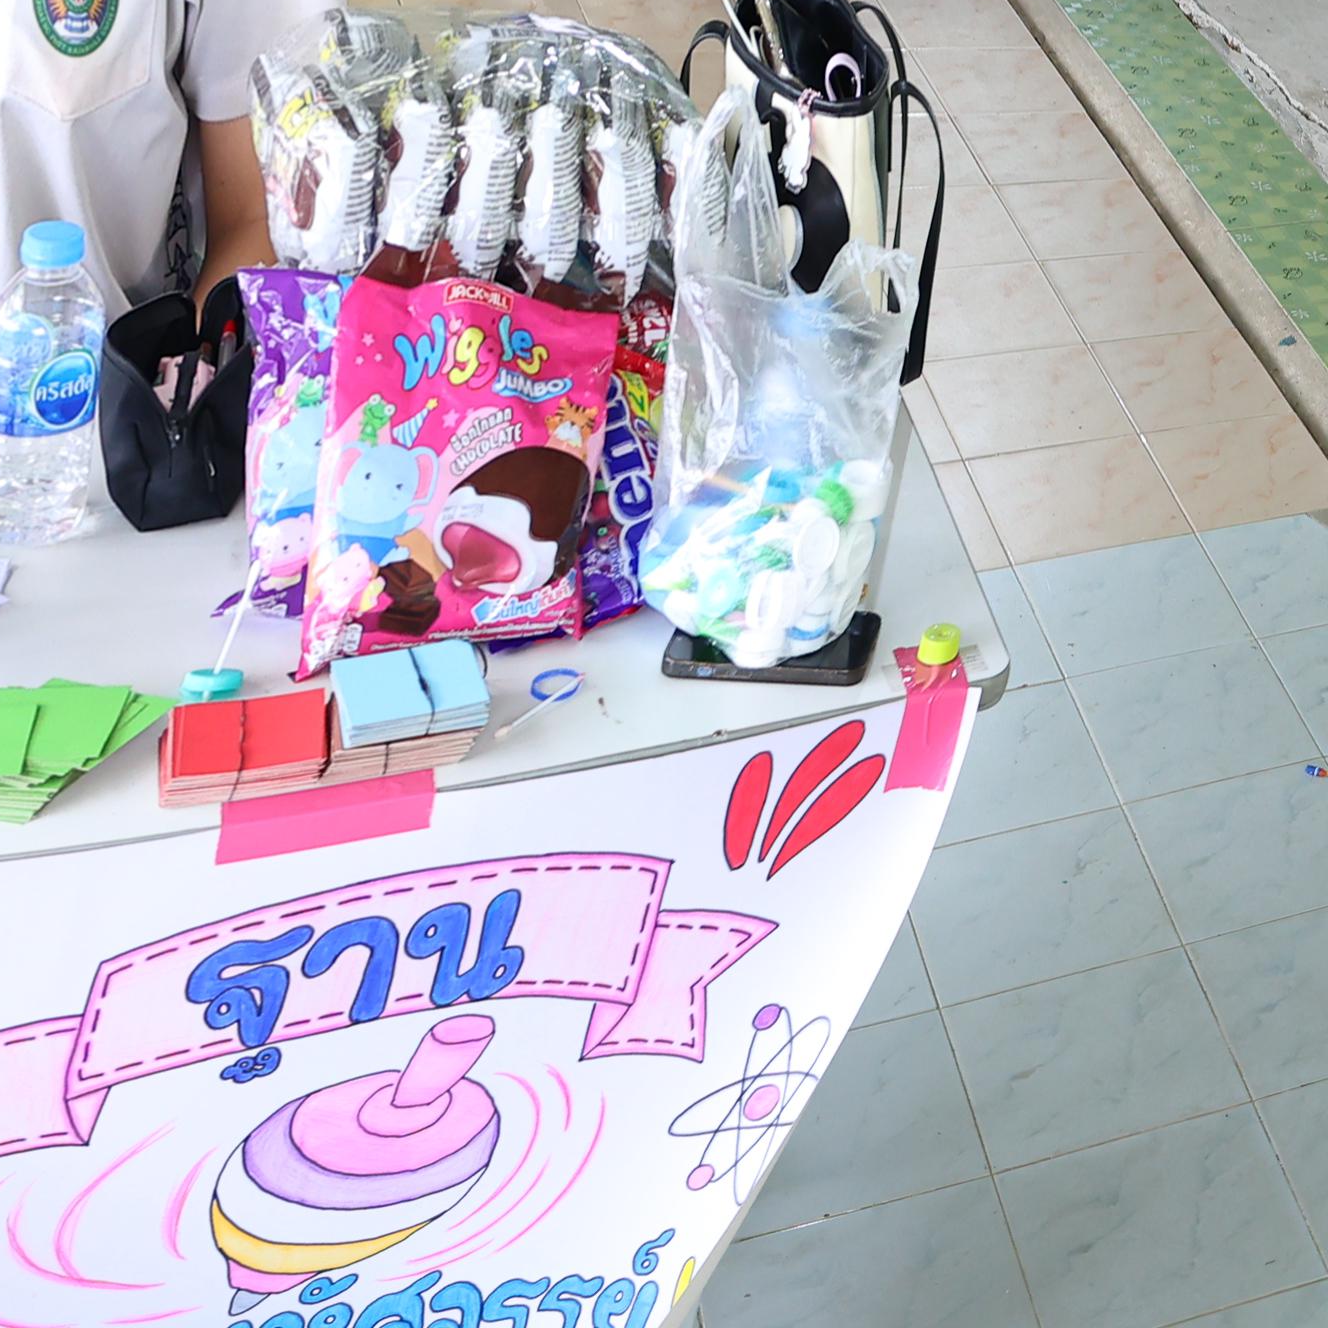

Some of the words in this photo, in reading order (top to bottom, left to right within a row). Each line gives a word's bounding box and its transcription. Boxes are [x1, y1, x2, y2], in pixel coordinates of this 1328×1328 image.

[394, 313, 550, 391] Wiggles
[494, 367, 565, 399] JUMBO
[449, 422, 523, 477] CHOCOLATE
[186, 888, 525, 1084] ฐาน
